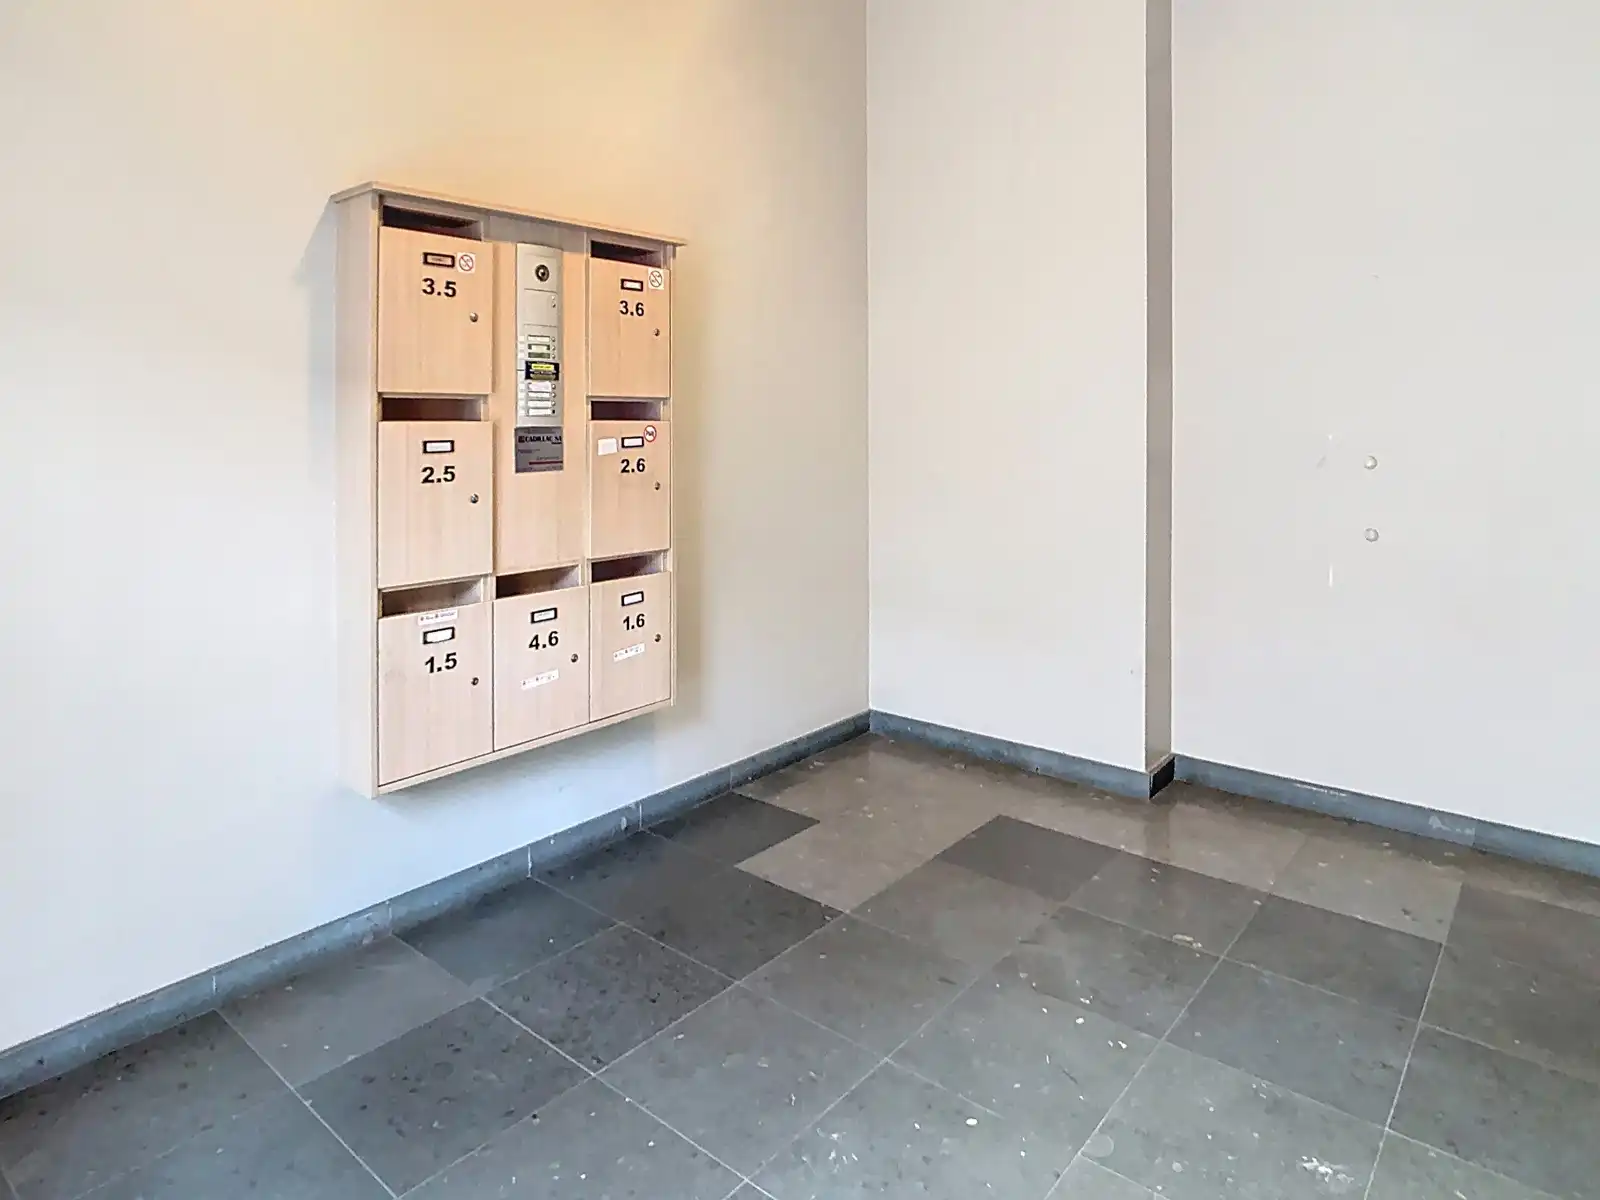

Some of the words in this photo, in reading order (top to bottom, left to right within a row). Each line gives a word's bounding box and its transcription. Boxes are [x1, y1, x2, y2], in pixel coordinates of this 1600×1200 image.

[421, 277, 457, 298] 3.5
[619, 299, 645, 317] 3.6
[421, 465, 456, 484] 2.5
[620, 457, 646, 474] 2.6
[623, 613, 645, 631] 1.6
[528, 630, 559, 650] 4.6
[424, 651, 458, 674] 1.5
